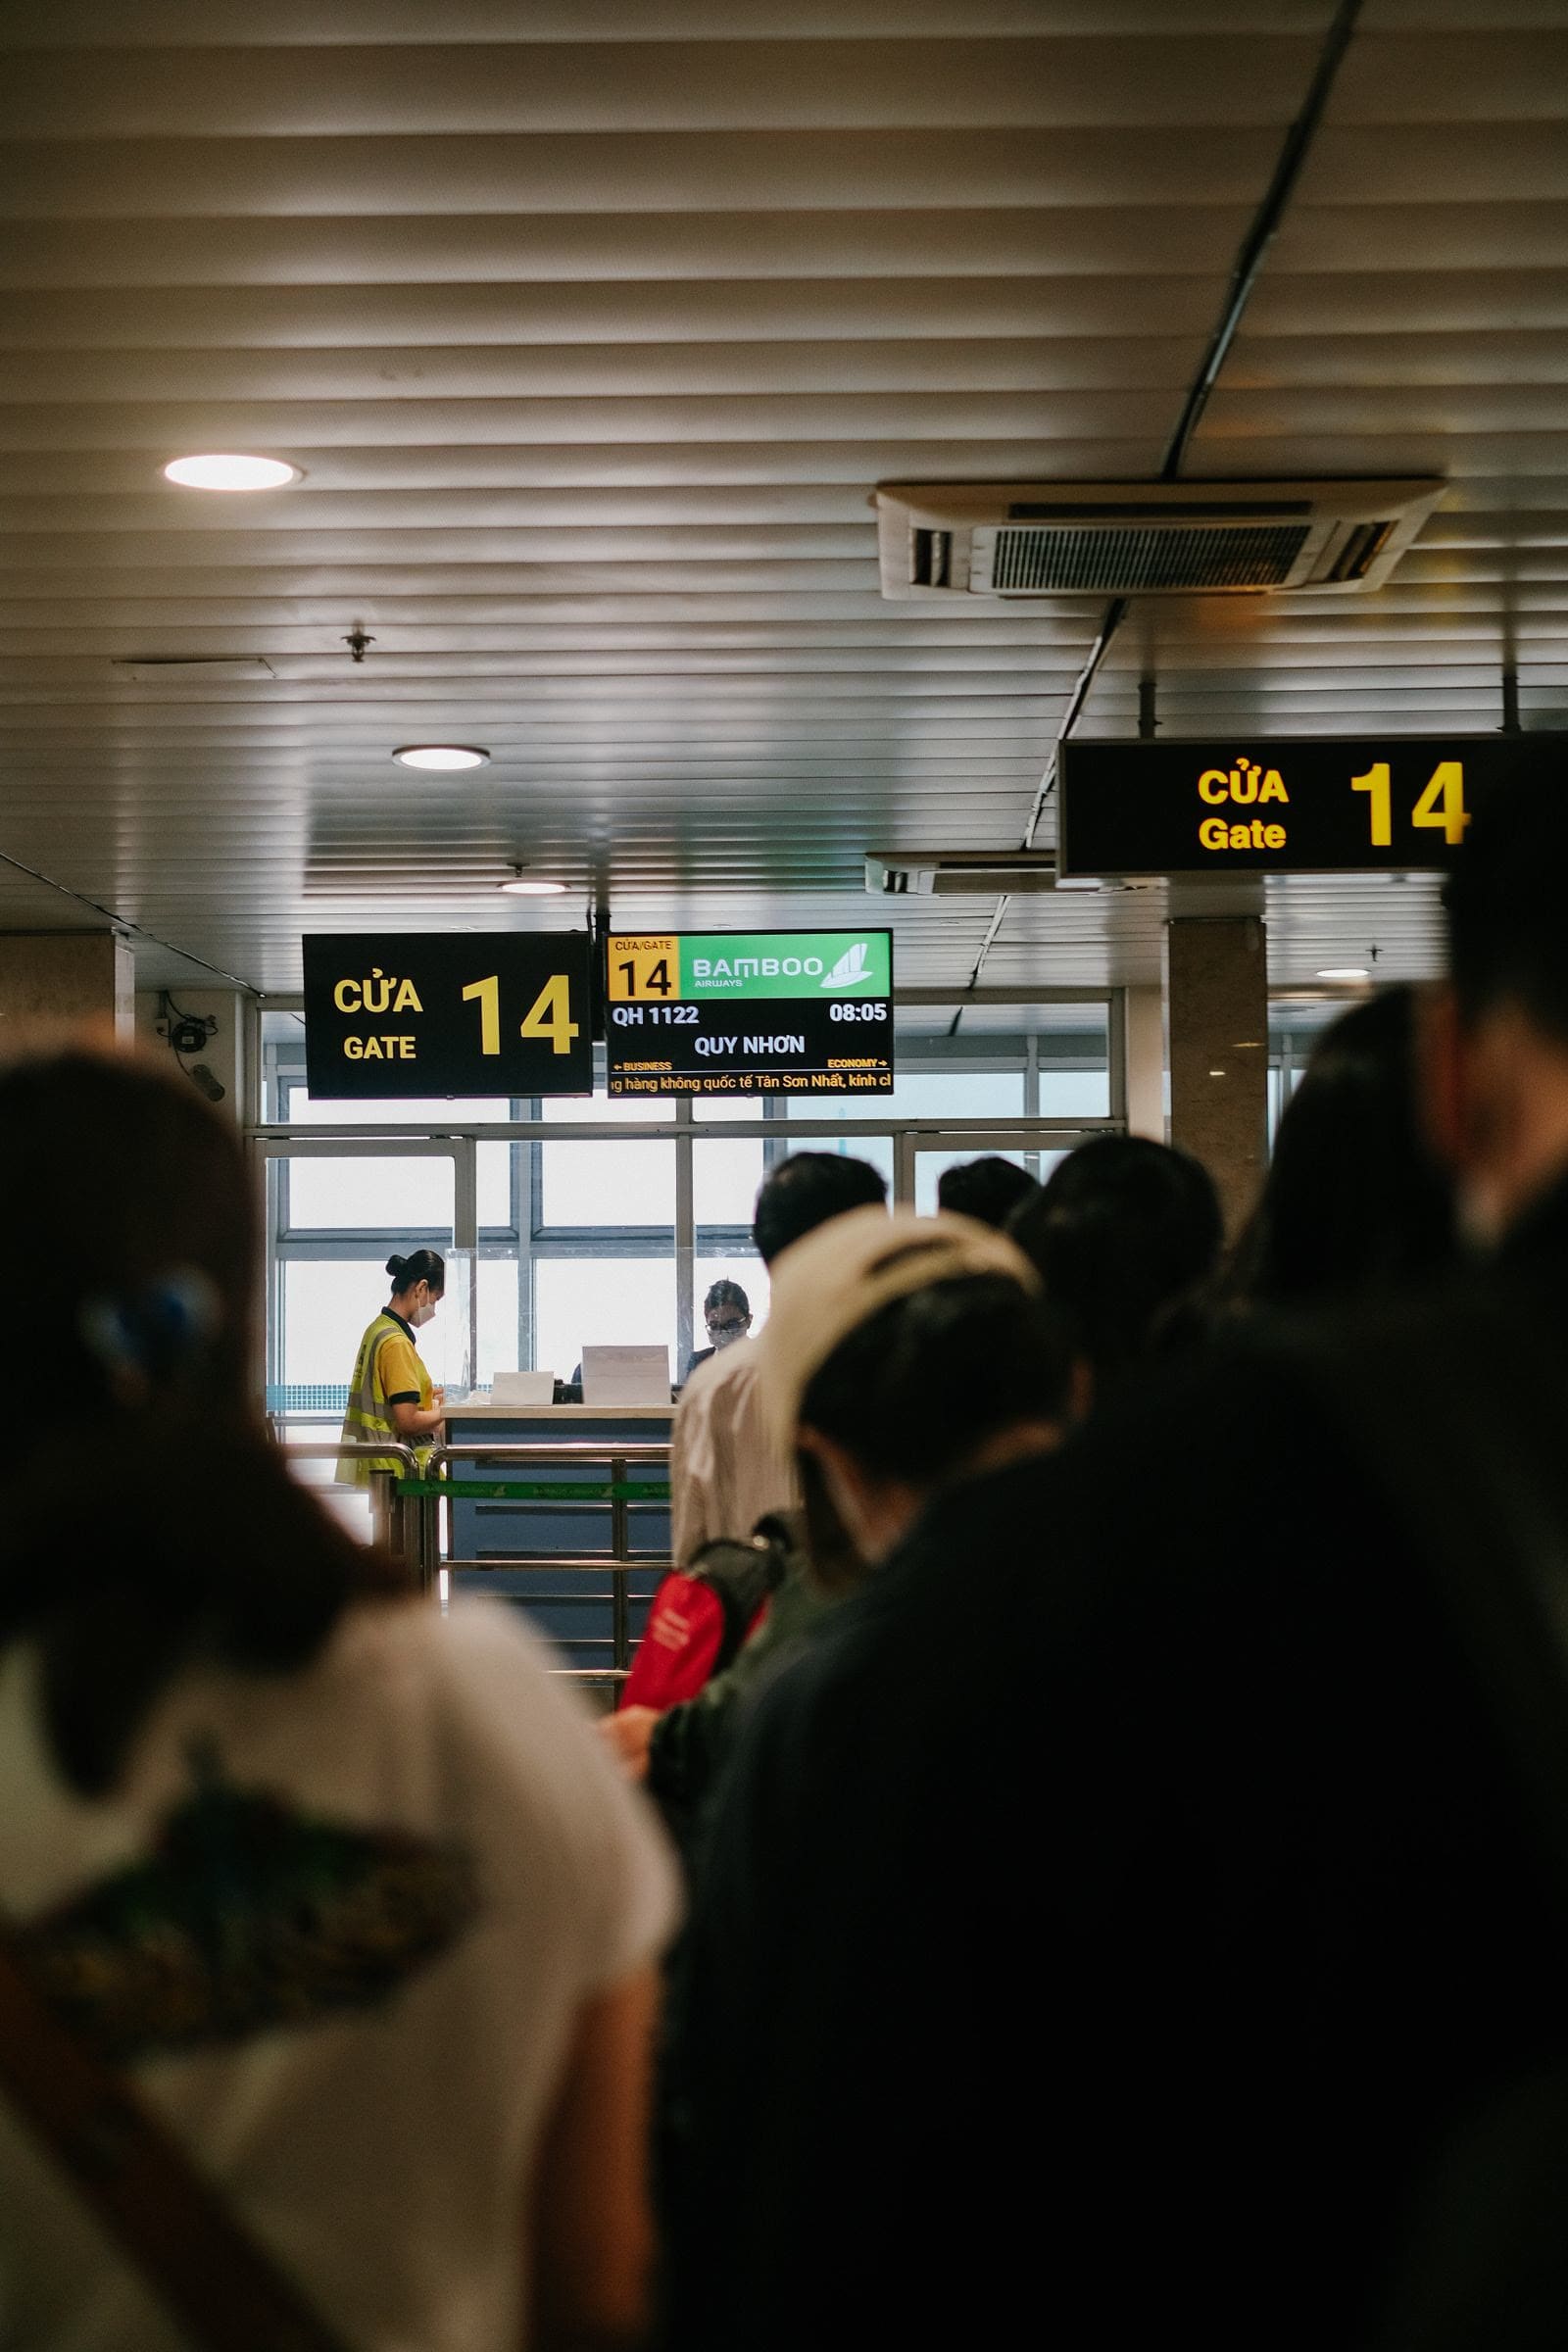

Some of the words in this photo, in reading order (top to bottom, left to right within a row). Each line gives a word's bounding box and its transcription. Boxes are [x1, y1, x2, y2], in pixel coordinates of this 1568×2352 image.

[1198, 758, 1290, 805] CỬA
[1350, 761, 1471, 847] 14
[1199, 818, 1287, 850] Gate
[615, 938, 672, 951] CỬA/GATE
[618, 958, 672, 997] 14
[693, 957, 823, 978] BAMBOO
[333, 967, 423, 1013] CỬA
[695, 979, 743, 988] AIRWAYS
[462, 974, 579, 1055] 14
[612, 1006, 644, 1027] QH
[649, 1005, 700, 1025] 1122
[829, 1003, 887, 1022] 08:05
[343, 1036, 416, 1059] GATE
[694, 1037, 738, 1056] QUY
[743, 1035, 806, 1054] NHƠN
[622, 1061, 672, 1071] BUSINESS
[827, 1058, 878, 1068] ECONOMY
[625, 1077, 659, 1093] hàng
[660, 1076, 702, 1093] không
[704, 1074, 737, 1091] quốc
[739, 1074, 754, 1088] tế
[756, 1075, 780, 1088] Tân
[782, 1074, 808, 1088] Sơn
